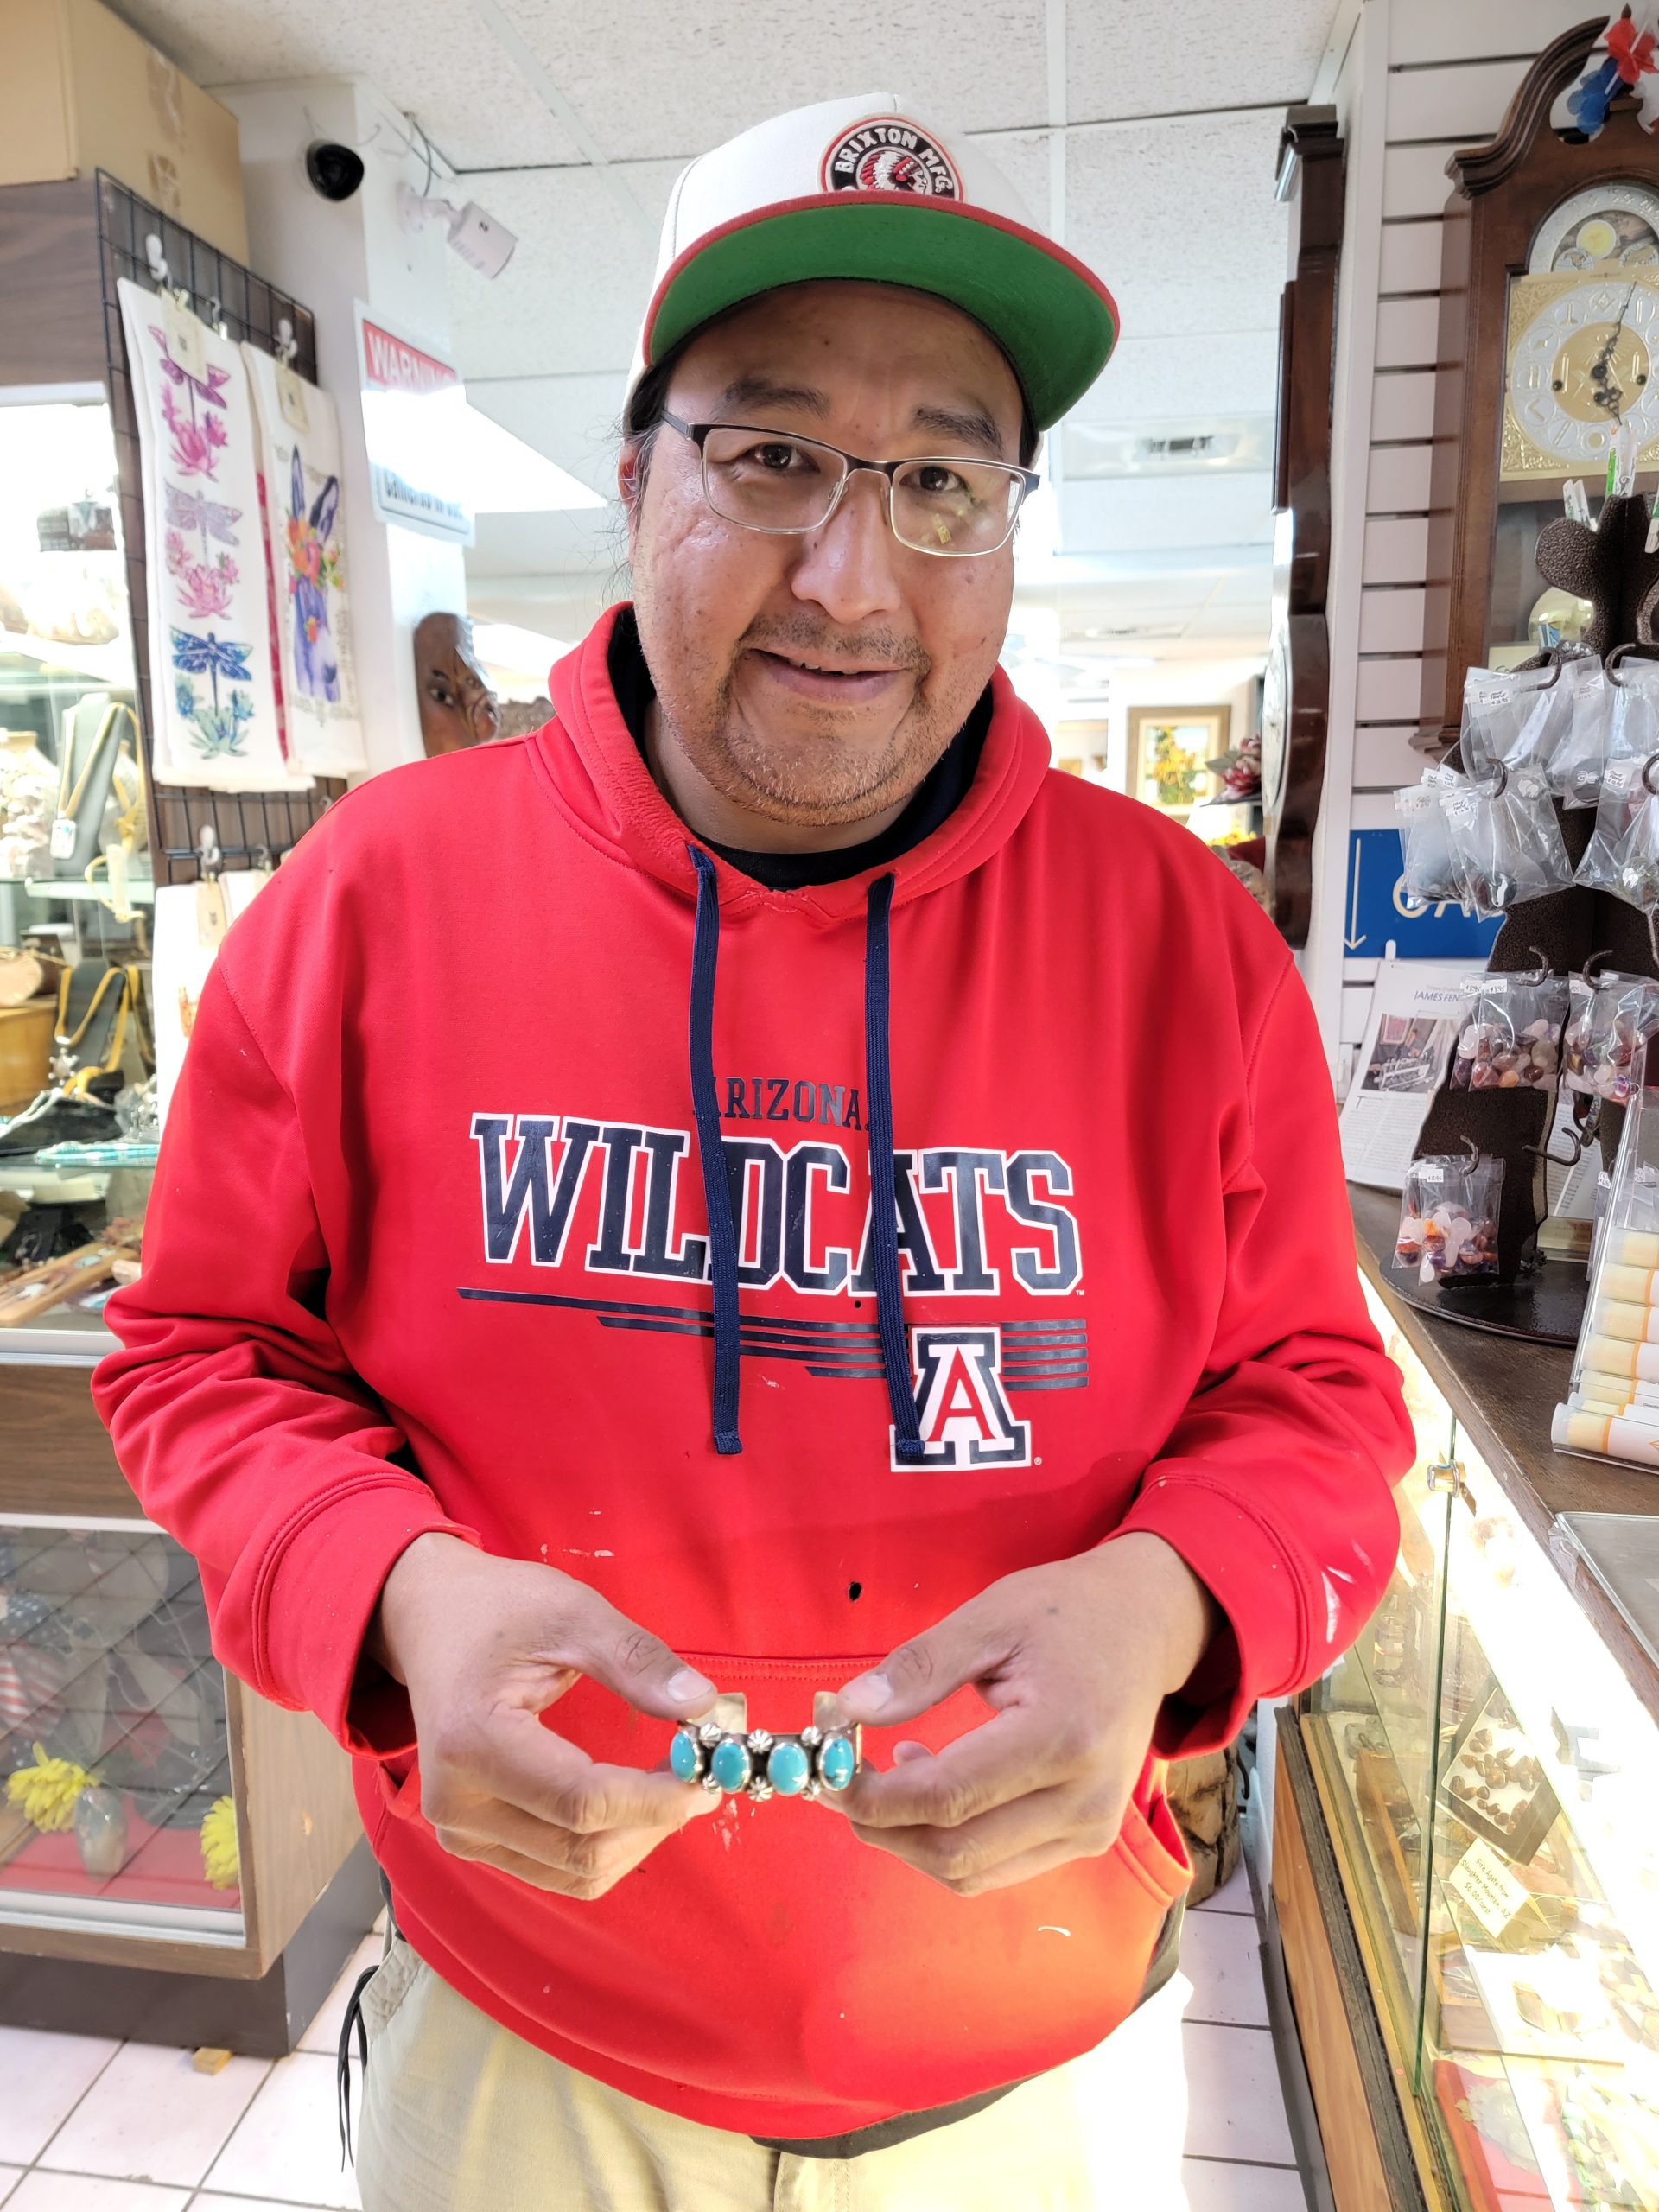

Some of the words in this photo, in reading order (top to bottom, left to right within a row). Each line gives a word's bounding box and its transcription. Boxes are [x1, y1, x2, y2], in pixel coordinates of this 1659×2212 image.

[835, 128, 918, 173] BRIXTON
[1414, 990, 1444, 1002] JAMES
[694, 1076, 862, 1132] RIZONA
[470, 1111, 1084, 1296] WILDCATS
[889, 1326, 1033, 1473] A
[1461, 1860, 1482, 1884] Slaughter
[1501, 1909, 1511, 1919] AZ
[1476, 1859, 1485, 1872] Fire
[1486, 1871, 1498, 1885] Agate
